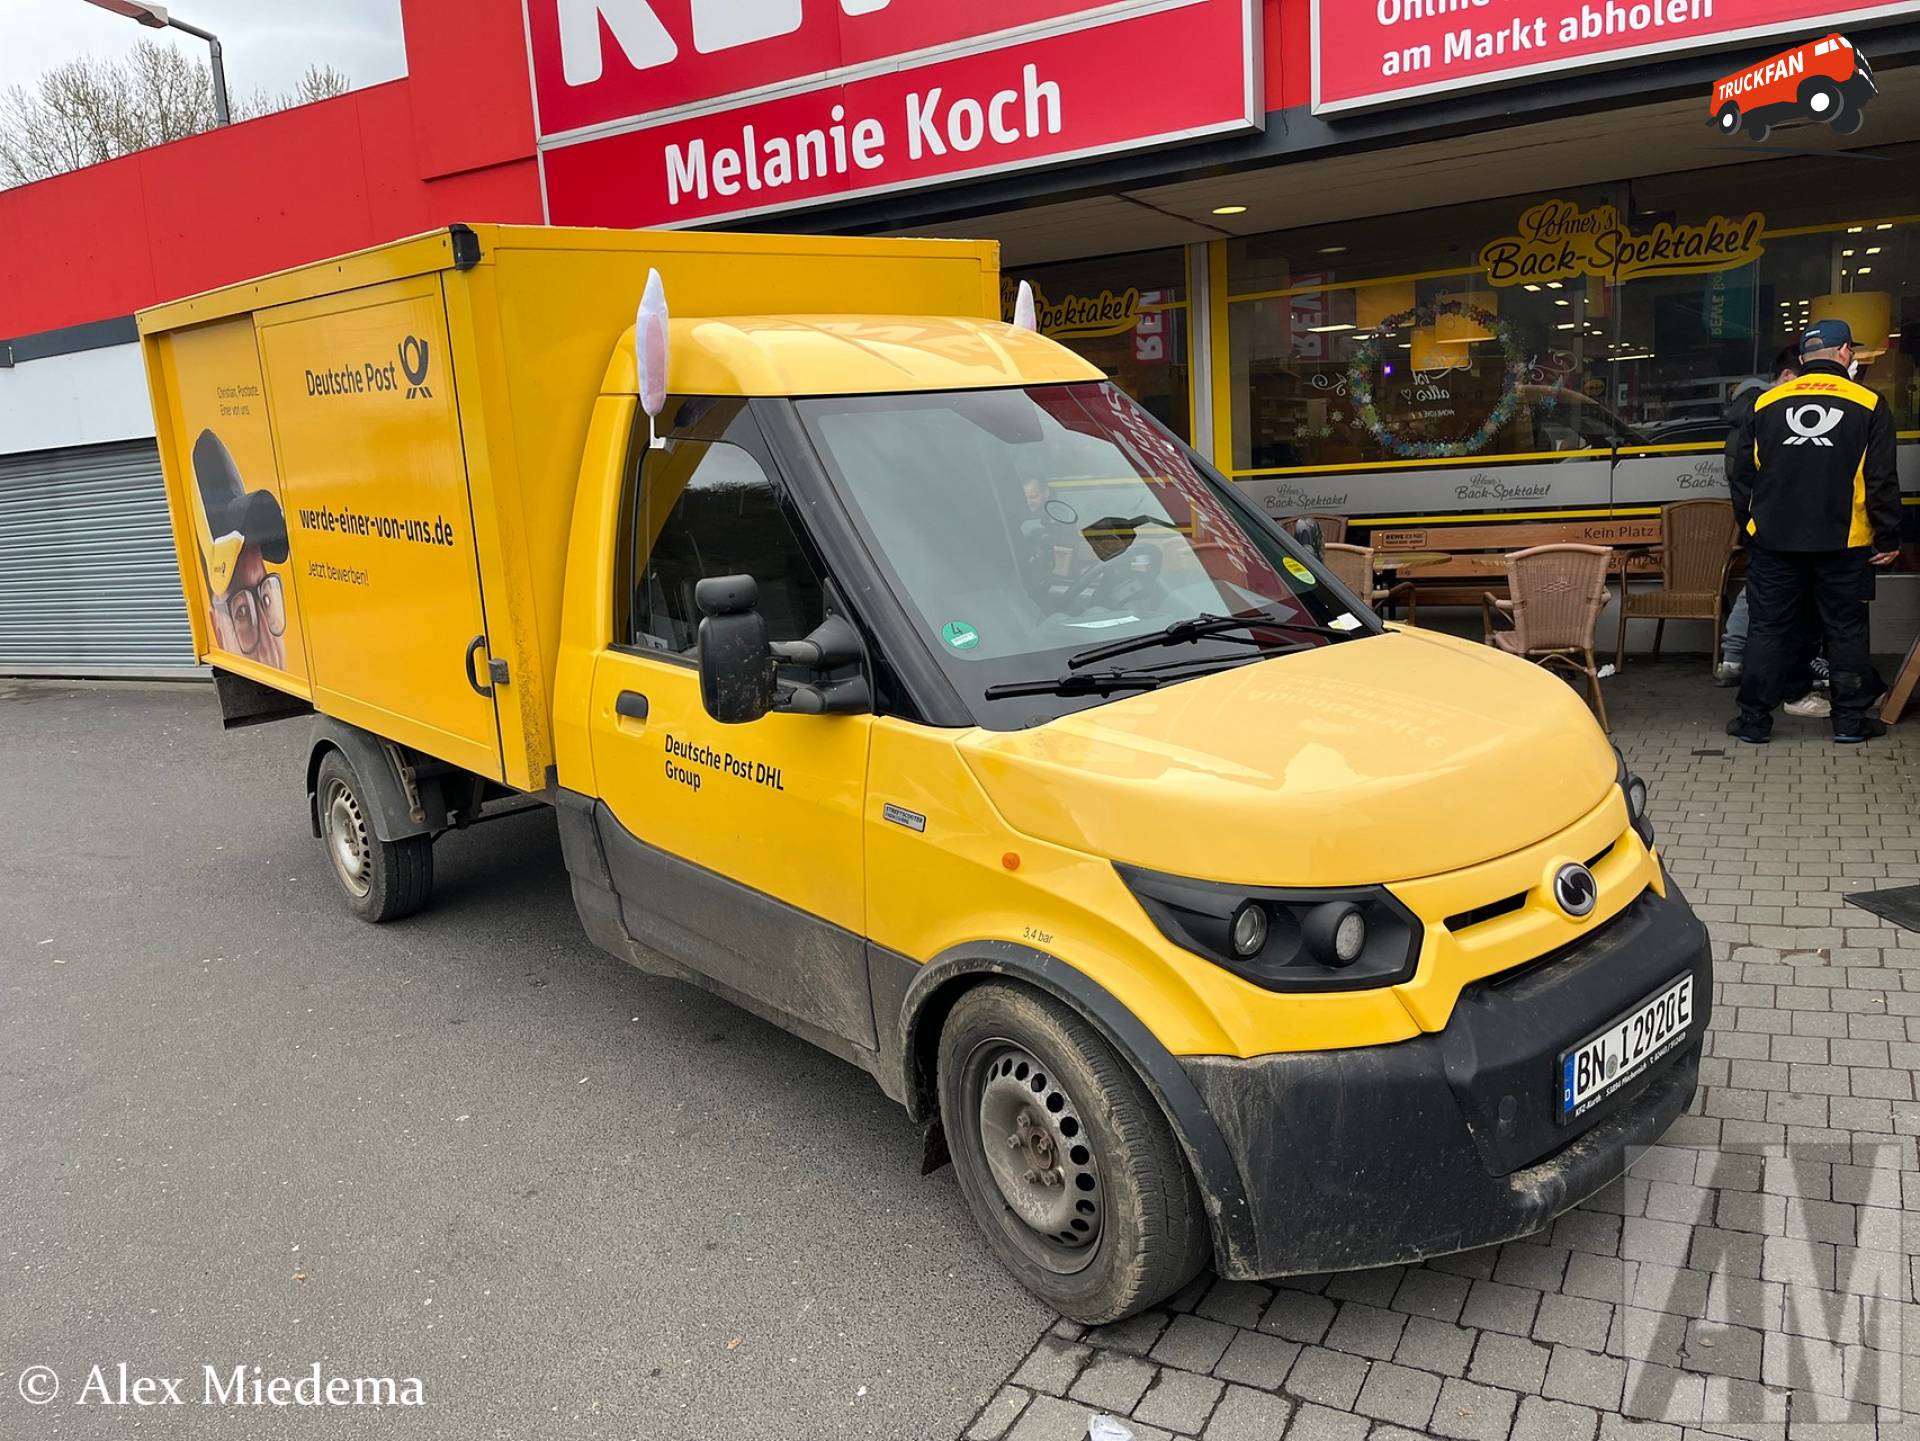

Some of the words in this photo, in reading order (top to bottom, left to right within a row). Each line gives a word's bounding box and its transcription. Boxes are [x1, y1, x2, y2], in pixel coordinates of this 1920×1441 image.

[1382, 43, 1432, 76] am
[1443, 17, 1548, 65] Markt
[1559, 0, 1714, 43] abholen
[664, 104, 885, 206] Melanie
[905, 63, 1062, 160] Koch
[1484, 219, 1758, 279] Back-Spektakel
[305, 363, 364, 396] Deutsche
[364, 361, 398, 392] Post
[1795, 383, 1838, 391] DHL
[1263, 494, 1349, 510] Back-Spektakel
[1454, 484, 1552, 501] Back-Spektakel
[299, 505, 454, 547] werde-einer-von-uns.de
[1584, 527, 1615, 540] Kein
[1619, 525, 1655, 537] Platz
[665, 733, 721, 769] Deutsche
[724, 752, 753, 781] Post
[755, 762, 784, 791] DHL
[665, 760, 701, 793] Group
[1023, 926, 1038, 940] 3,4
[1038, 930, 1054, 944] bar
[1578, 1039, 1605, 1097] BN
